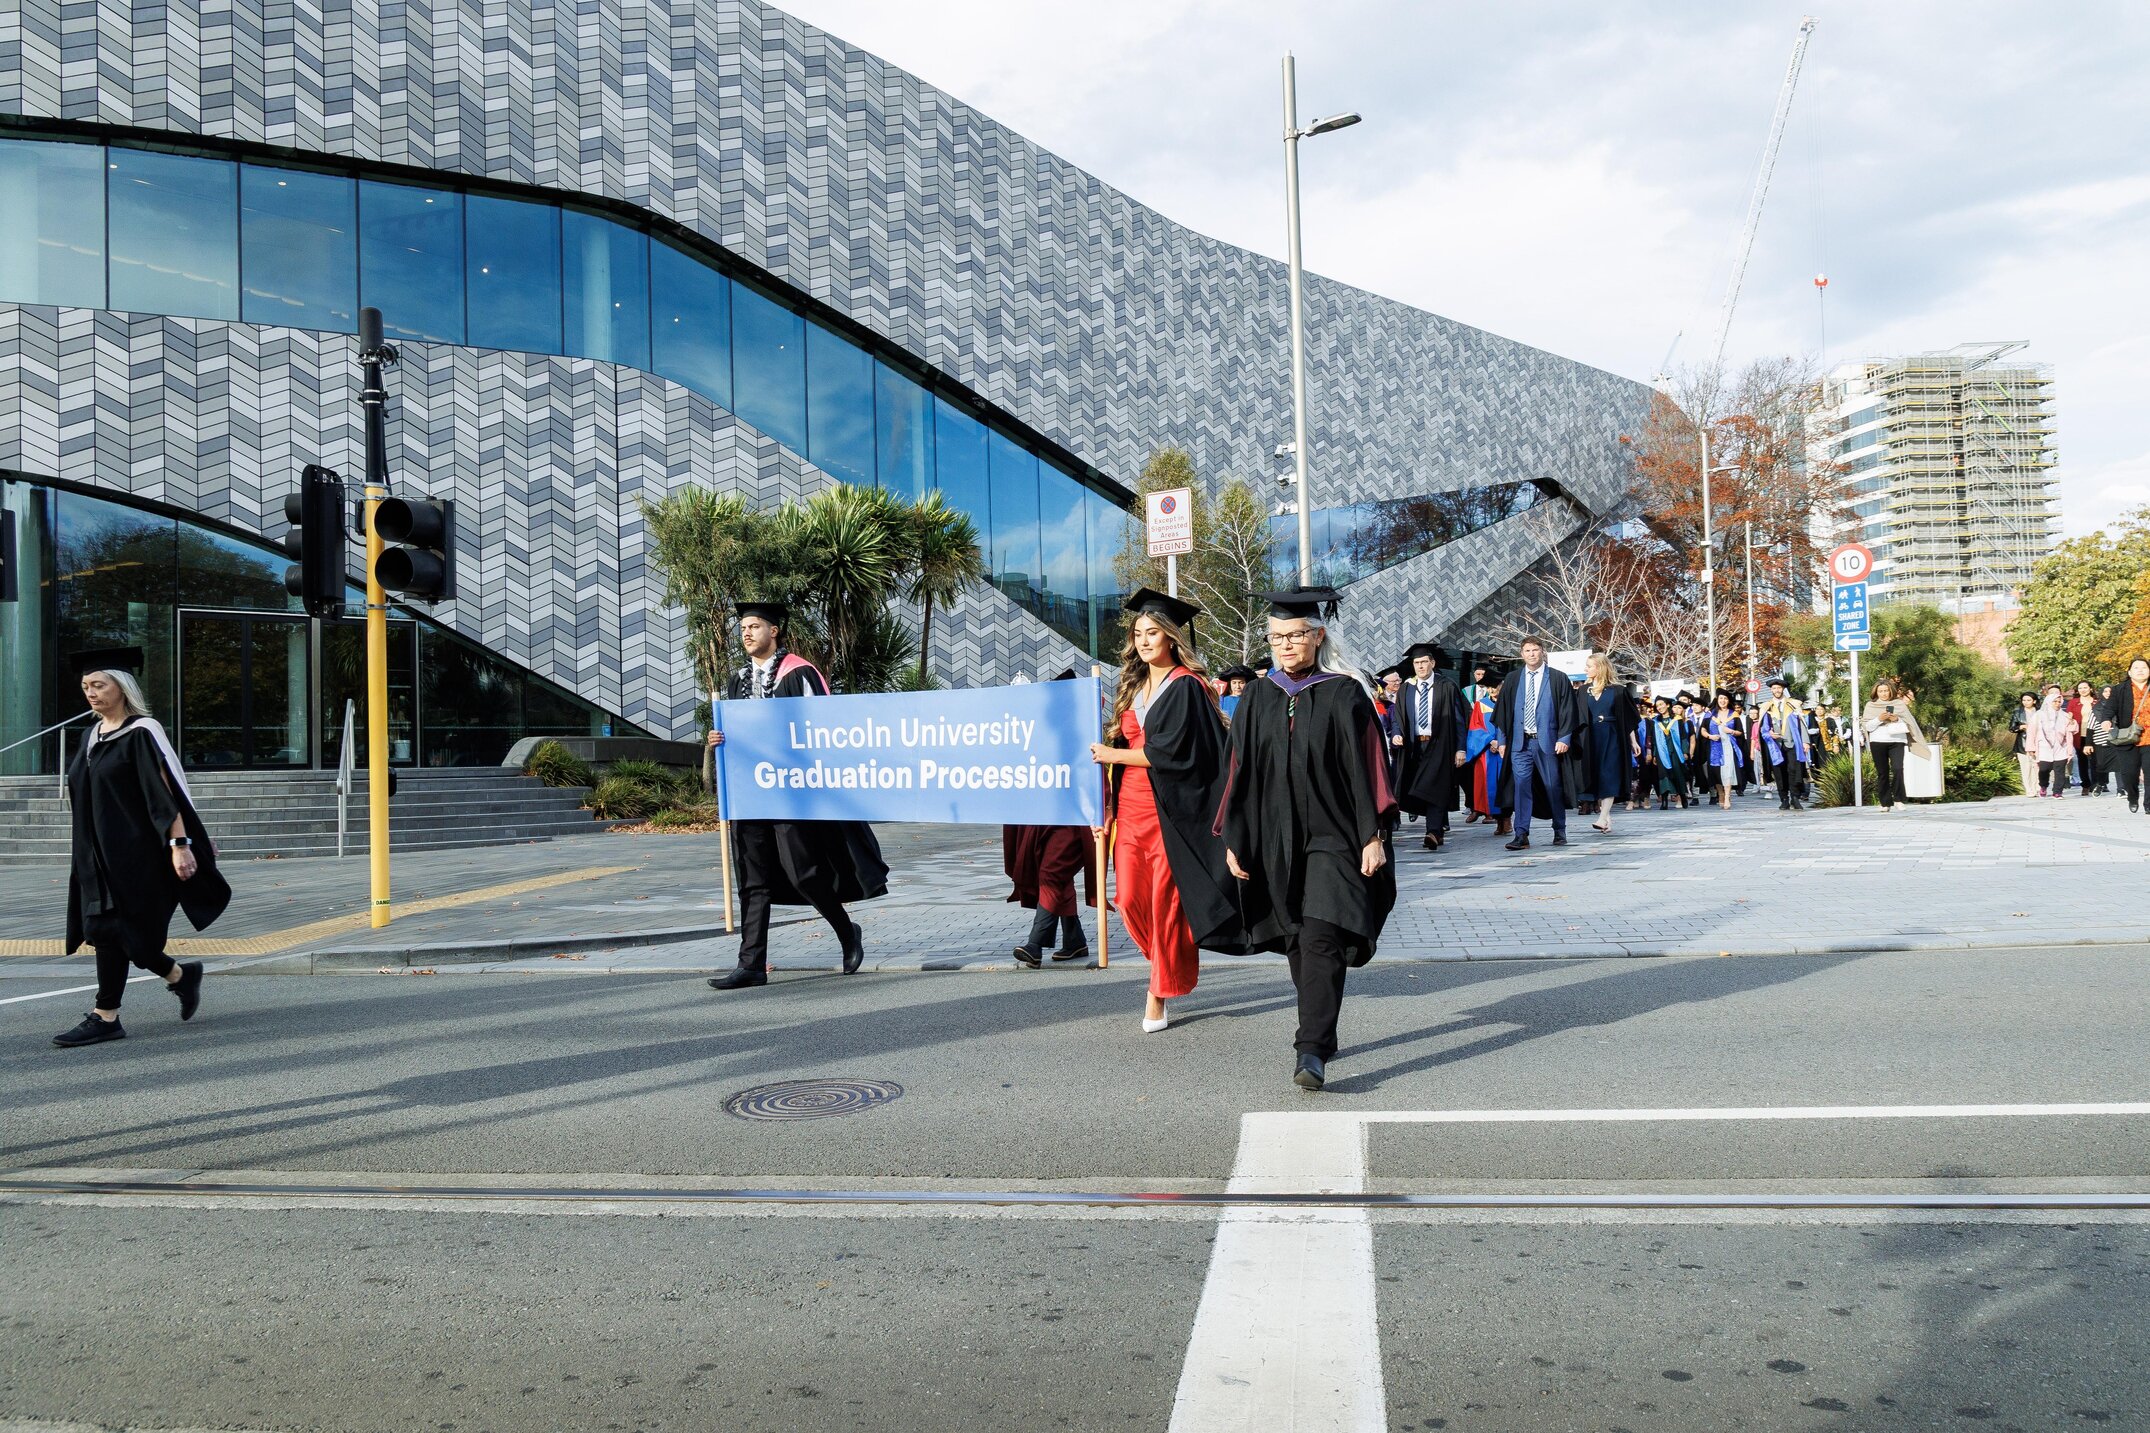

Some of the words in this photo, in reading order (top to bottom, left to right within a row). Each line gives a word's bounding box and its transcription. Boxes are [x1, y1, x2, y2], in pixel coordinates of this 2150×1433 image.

[1154, 516, 1176, 525] Except
[1151, 522, 1188, 533] Signposted
[1152, 541, 1187, 552] BEGINS
[1842, 555, 1860, 570] 10
[1838, 610, 1864, 621] SHARED
[1842, 620, 1860, 630] ZONE
[789, 717, 891, 750] Lincoln
[900, 712, 1036, 751] University
[754, 758, 912, 790] Graduation
[919, 755, 1072, 790] Procession
